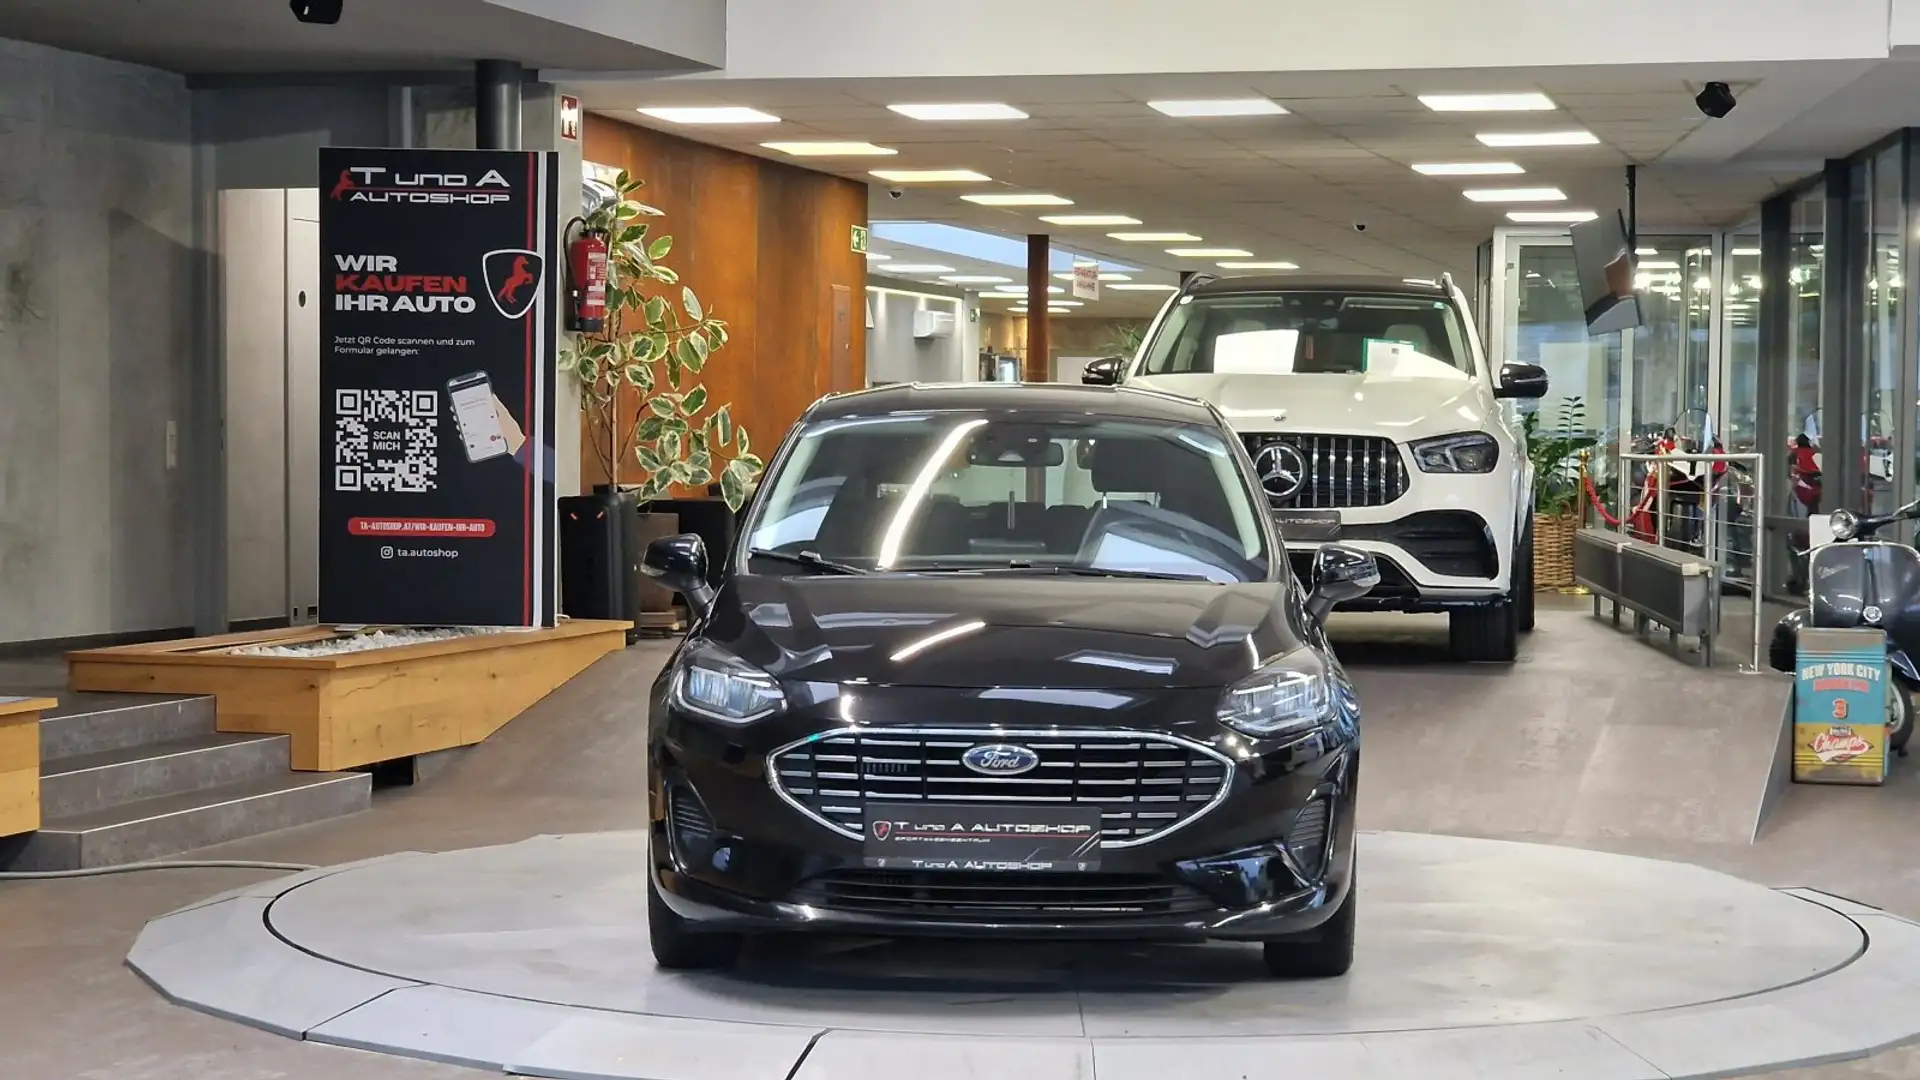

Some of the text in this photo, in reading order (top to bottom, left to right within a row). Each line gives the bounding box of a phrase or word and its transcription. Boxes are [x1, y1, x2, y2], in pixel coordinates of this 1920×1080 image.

[350, 167, 386, 184] T
[475, 169, 510, 187] A
[350, 191, 510, 204] AUTOSHOP
[335, 254, 397, 272] WIR
[335, 275, 467, 293] KAUFEN
[335, 294, 476, 313] IHR AUTO
[334, 336, 355, 344] Jetzt
[357, 336, 371, 345] QR
[373, 337, 396, 345] Code
[397, 338, 435, 346] scannen
[436, 338, 454, 346] und
[334, 346, 420, 357] Formular gelangen:
[373, 430, 400, 440] SCAN
[373, 441, 400, 451] MICH
[397, 548, 459, 559] ta.autoshop
[1802, 662, 1880, 681] NEW YORK CITY
[980, 750, 1021, 768] Ford
[894, 821, 910, 830] T
[951, 822, 965, 831] A
[971, 823, 1091, 833] AUTOSHOP
[912, 860, 924, 868] T
[947, 860, 959, 869] A
[964, 860, 1052, 871] AUTOSHOP
